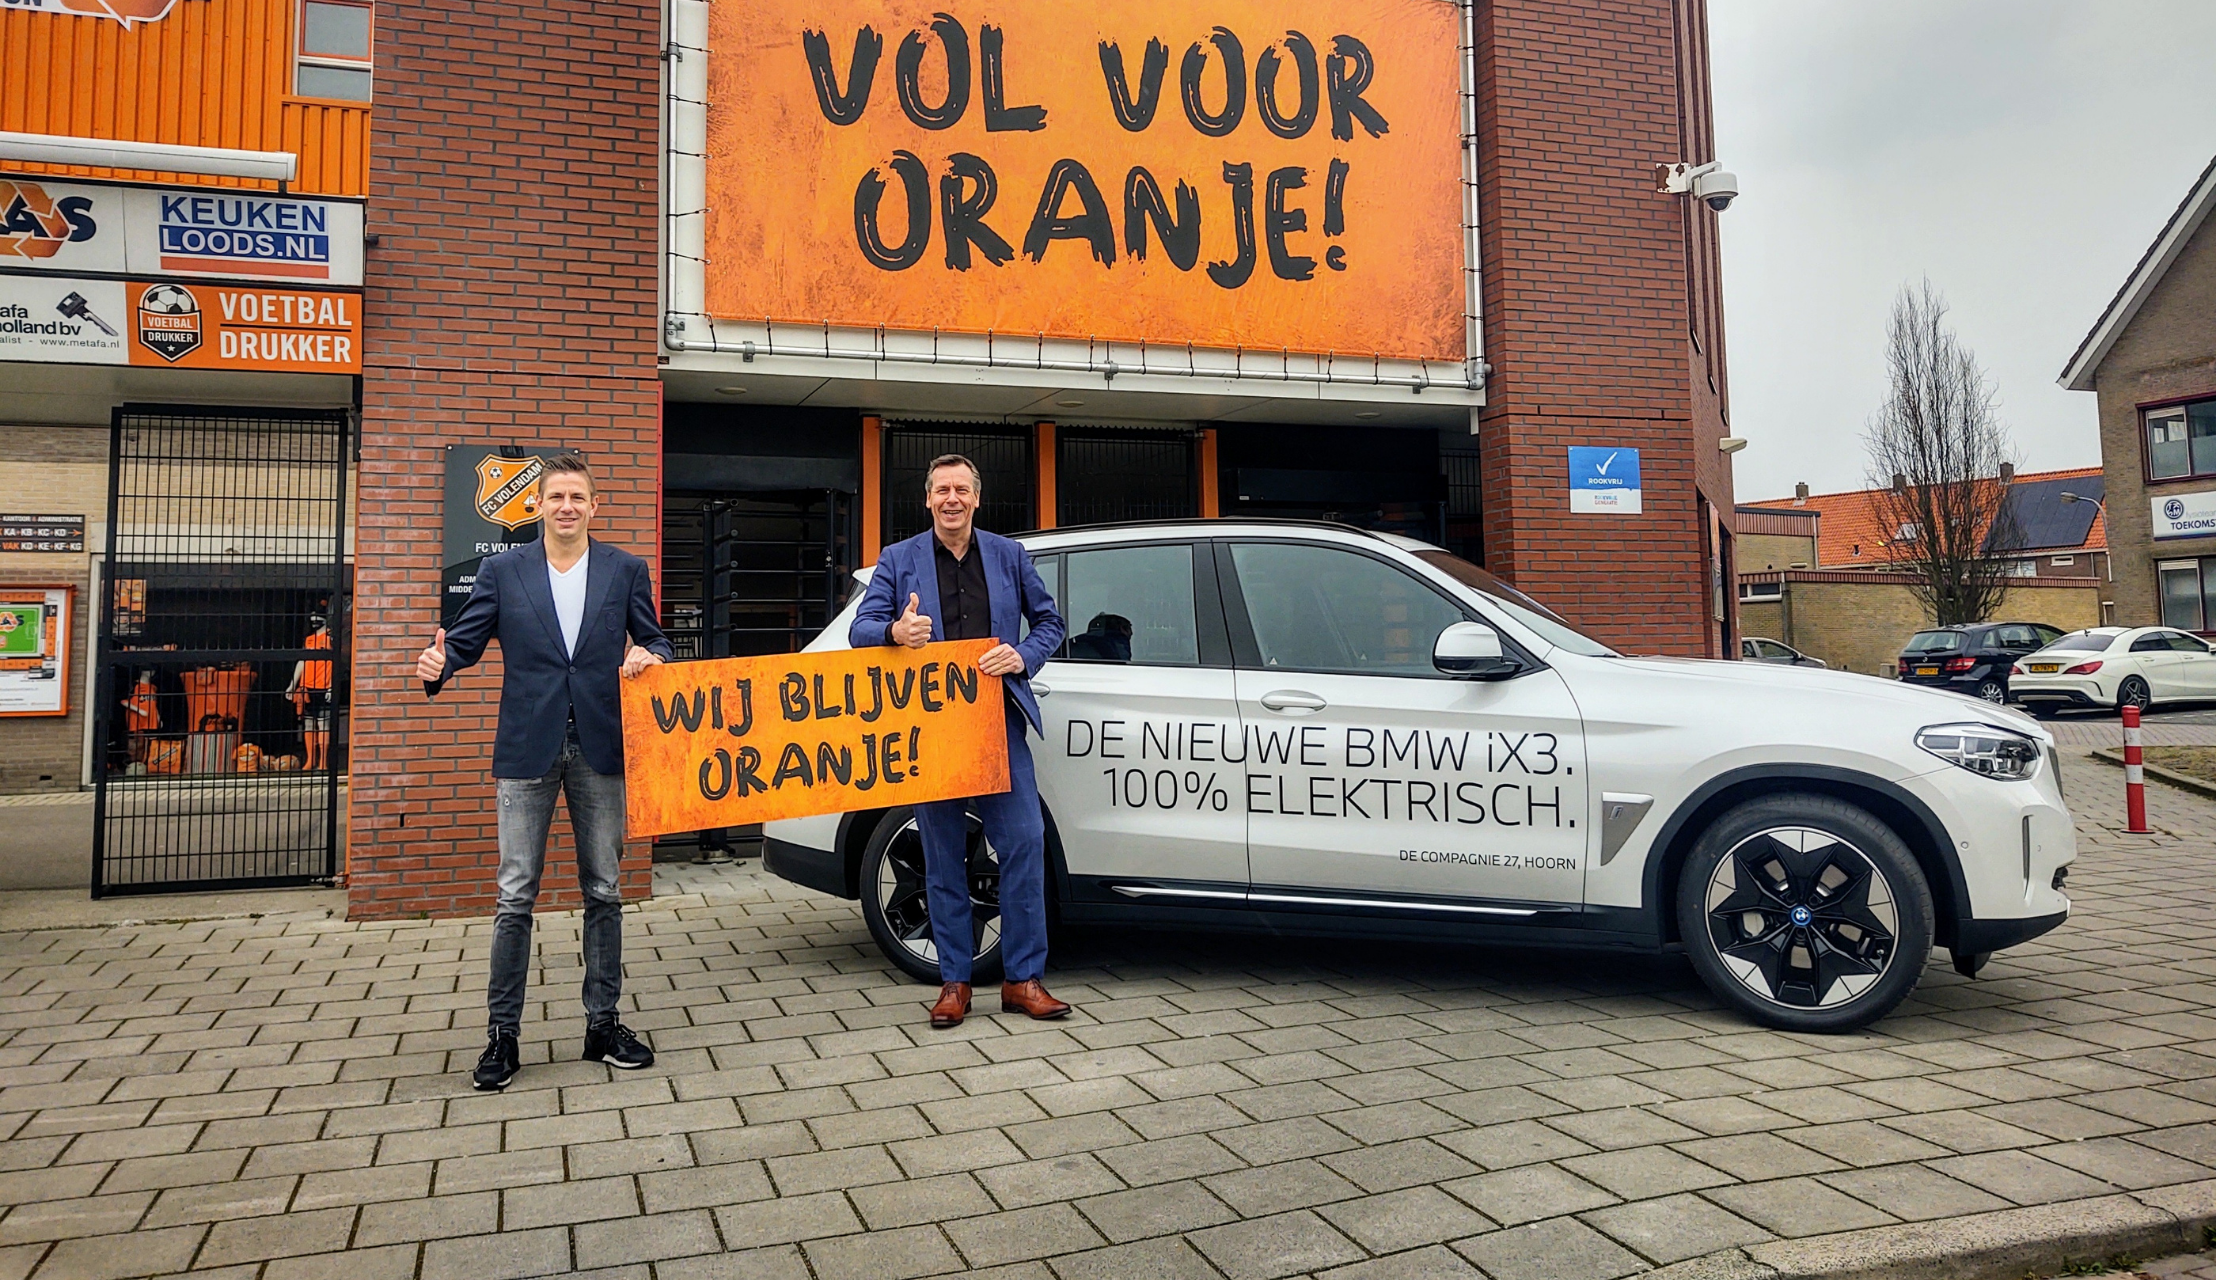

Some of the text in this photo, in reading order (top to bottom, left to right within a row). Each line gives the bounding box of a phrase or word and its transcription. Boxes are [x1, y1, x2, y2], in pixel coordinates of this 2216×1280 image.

[803, 13, 1390, 141] VOL VOOR
[0, 193, 97, 243] AS
[161, 196, 325, 232] KEUKEN
[854, 149, 1350, 289] ORANJE!
[162, 228, 326, 260] LOODS.NL
[147, 316, 193, 329] VOETBAL
[219, 292, 352, 326] VOETBAL
[40, 338, 119, 349] www.metafa.nl
[59, 321, 81, 335] bv
[147, 331, 193, 343] DRUKKER
[220, 331, 352, 363] DRUKKER
[481, 462, 543, 515] FC VOLENDAM
[2171, 519, 2216, 530] TOEKOMS
[2, 542, 20, 550] VAK
[475, 542, 489, 553] FC
[650, 661, 978, 737] WIJ BLIJVEN
[698, 725, 921, 801] ORANJE!
[1067, 718, 1575, 776] DE NIEUWE BMW iX3.
[1102, 768, 1576, 828] 100% ELEKTRISCH.
[1399, 849, 1576, 869] DE COMPAGNIE 27, HOORN
